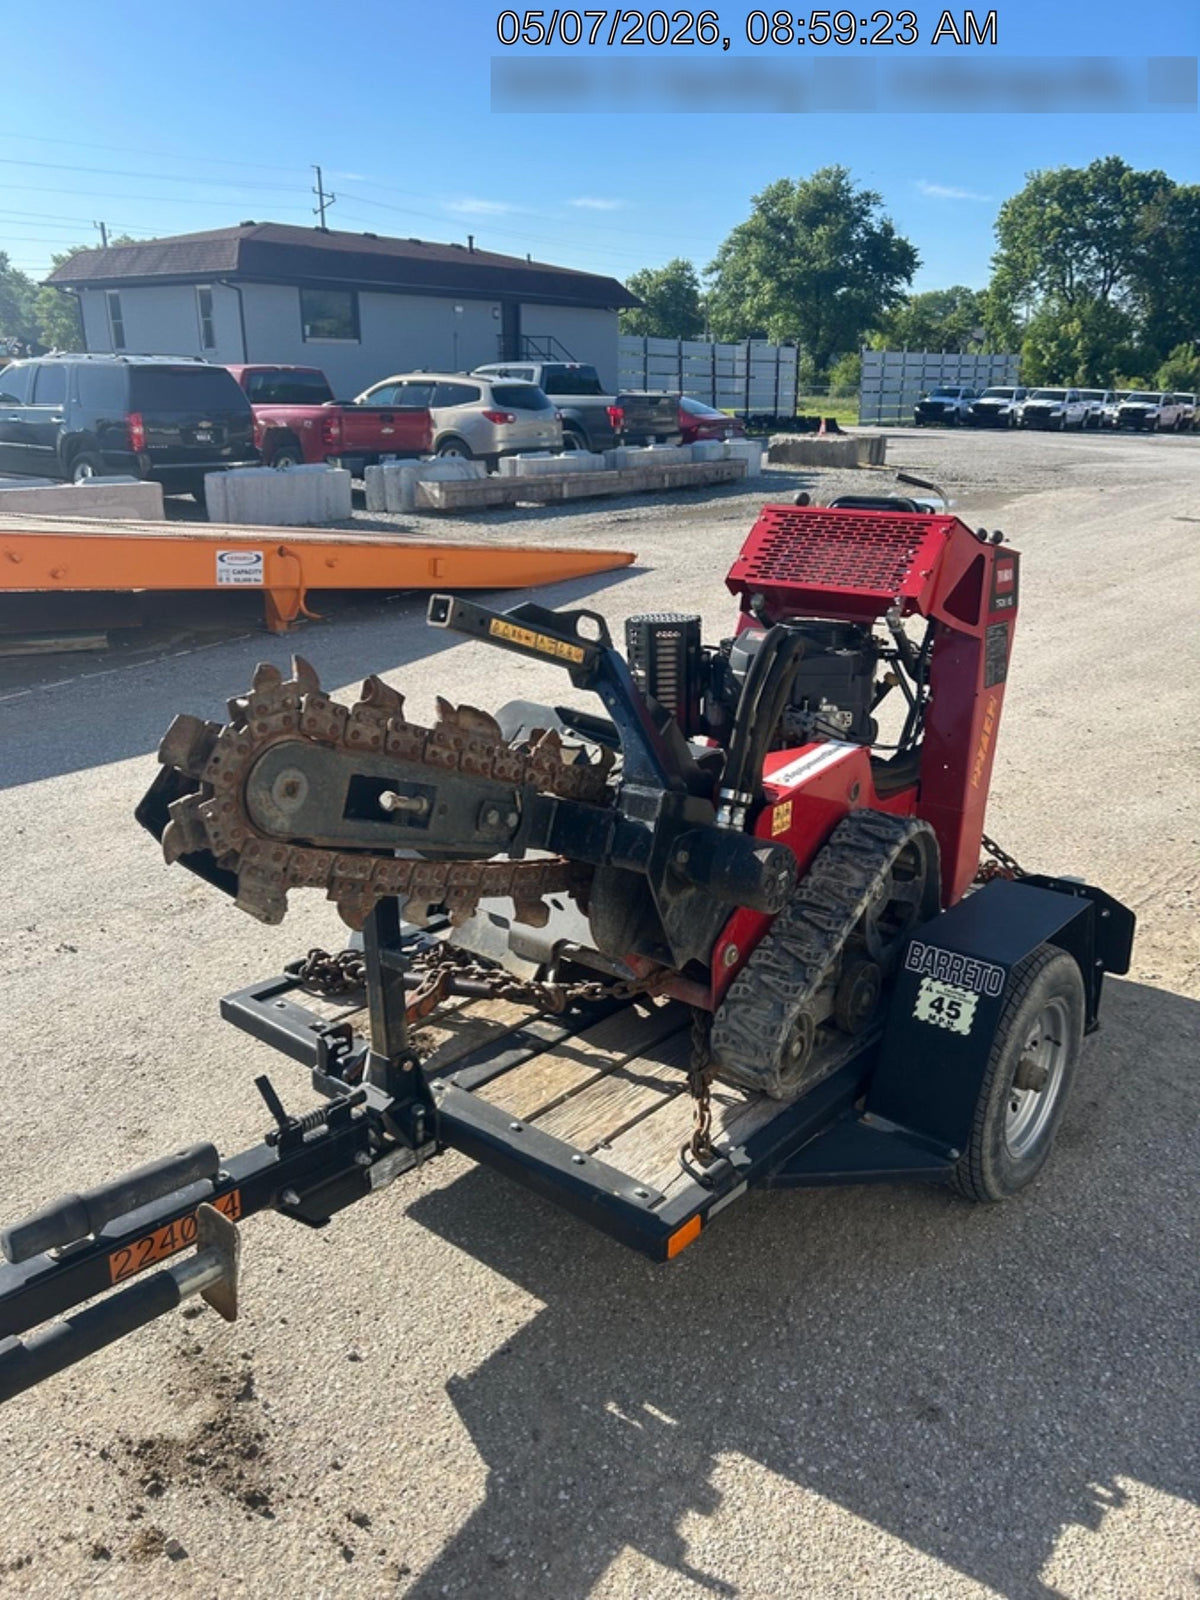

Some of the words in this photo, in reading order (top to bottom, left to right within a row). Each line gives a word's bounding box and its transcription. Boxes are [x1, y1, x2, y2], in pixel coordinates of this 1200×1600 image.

[905, 940, 1005, 997] BARRETO
[928, 996, 963, 1020] 45
[113, 1193, 239, 1281] 22404
